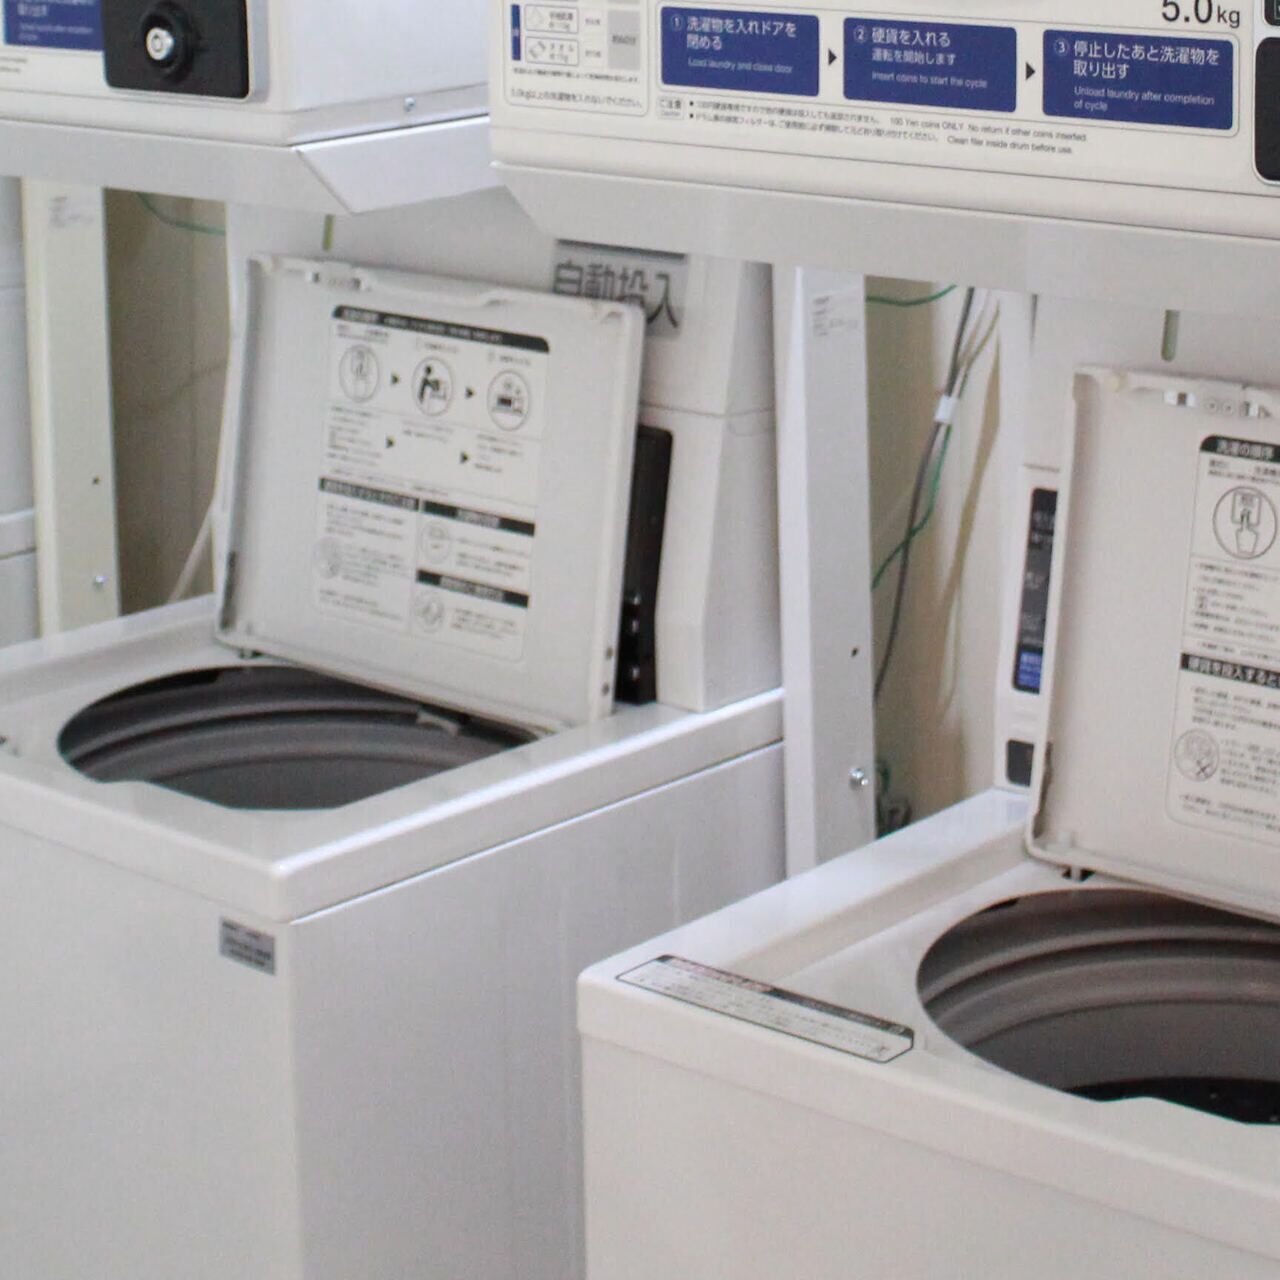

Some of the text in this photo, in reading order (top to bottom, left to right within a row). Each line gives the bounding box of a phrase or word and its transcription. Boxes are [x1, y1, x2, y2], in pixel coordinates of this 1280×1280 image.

[687, 16, 798, 38] 洗濯物を入れドアを
[871, 27, 951, 48] 硬貨を入れる
[686, 33, 723, 51] 閉める
[1073, 39, 1219, 66] 停止したあと洗濯物を
[872, 47, 957, 66] 運転を開始します
[1073, 59, 1130, 80] 取り出す
[1073, 99, 1108, 112] of cycle
[1074, 85, 1215, 106] Unload laundry after completion
[942, 121, 964, 131] ONLY
